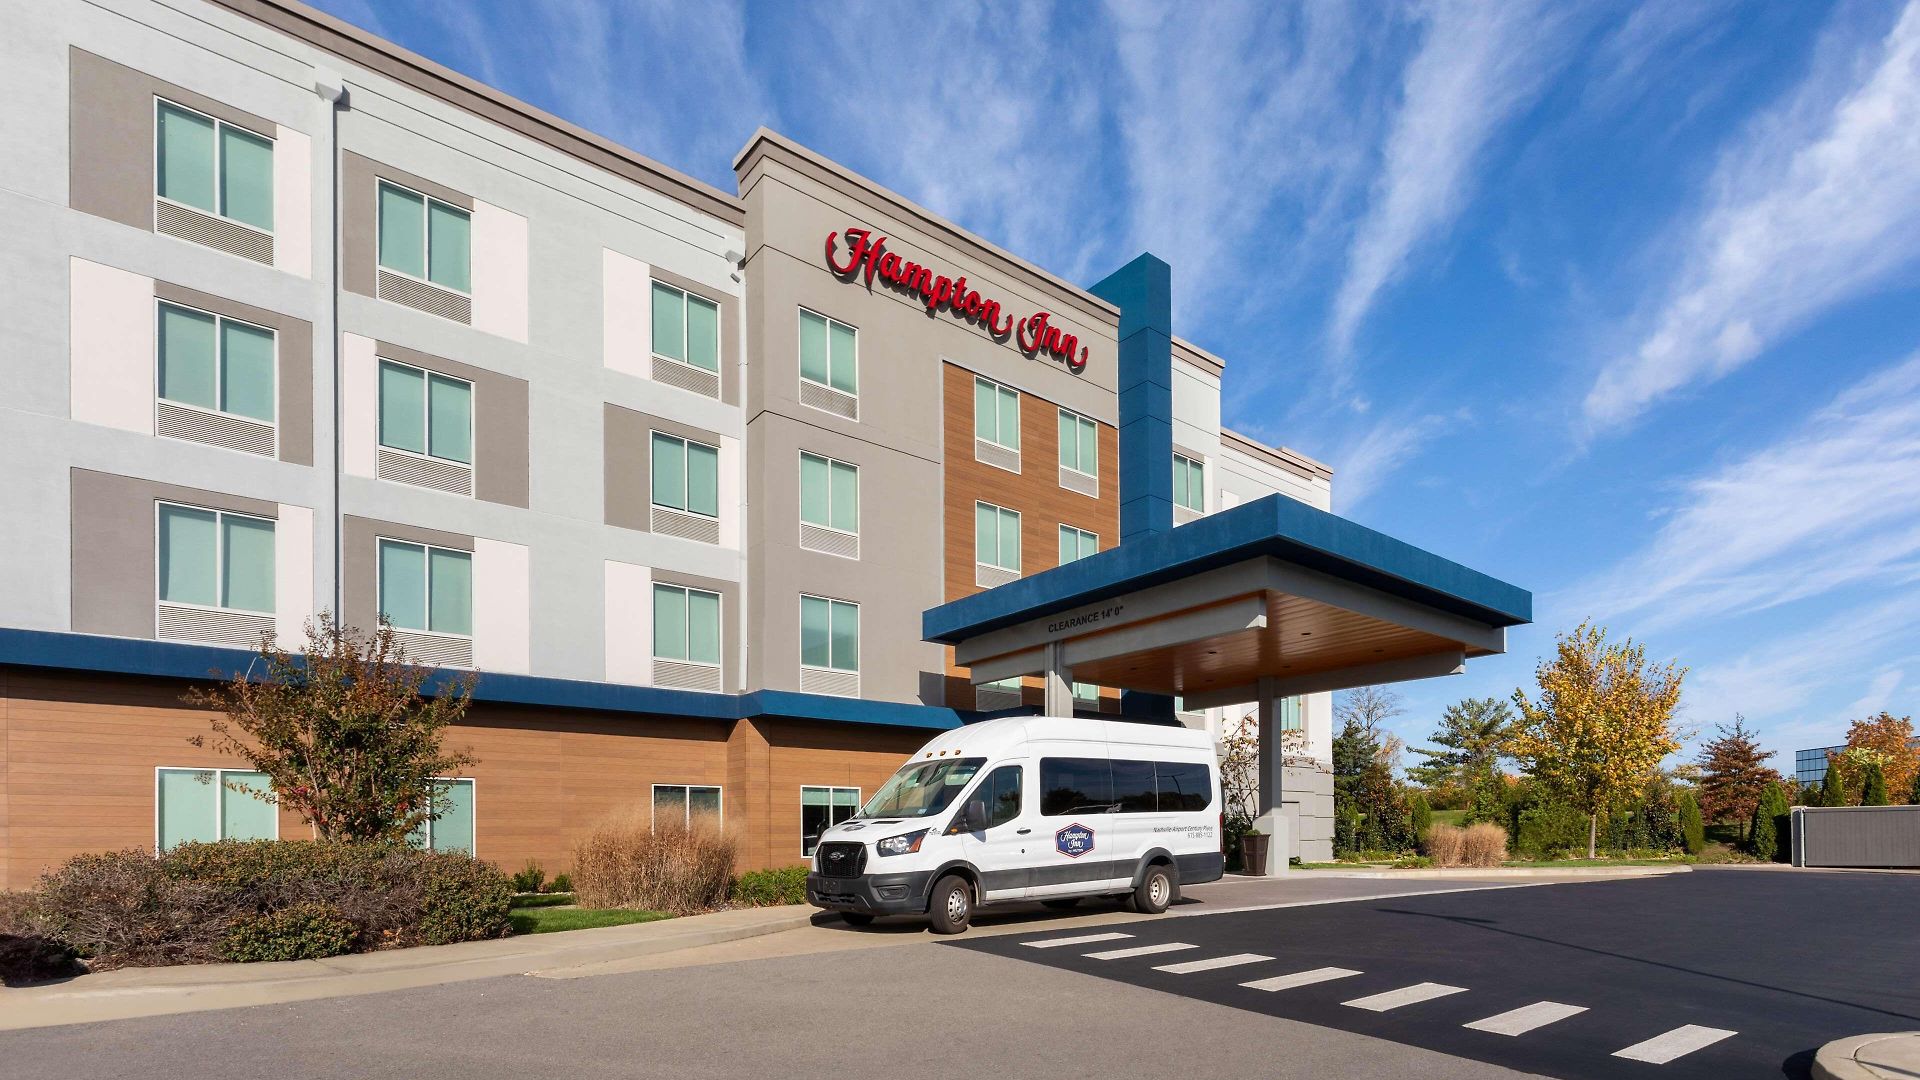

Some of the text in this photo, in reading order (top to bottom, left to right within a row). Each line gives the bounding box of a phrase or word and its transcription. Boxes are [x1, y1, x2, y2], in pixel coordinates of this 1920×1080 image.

[826, 228, 1088, 367] Hampton Inn
[1048, 612, 1100, 633] CLEARANCE
[1060, 830, 1089, 842] Hampton
[1067, 838, 1084, 849] Inn
